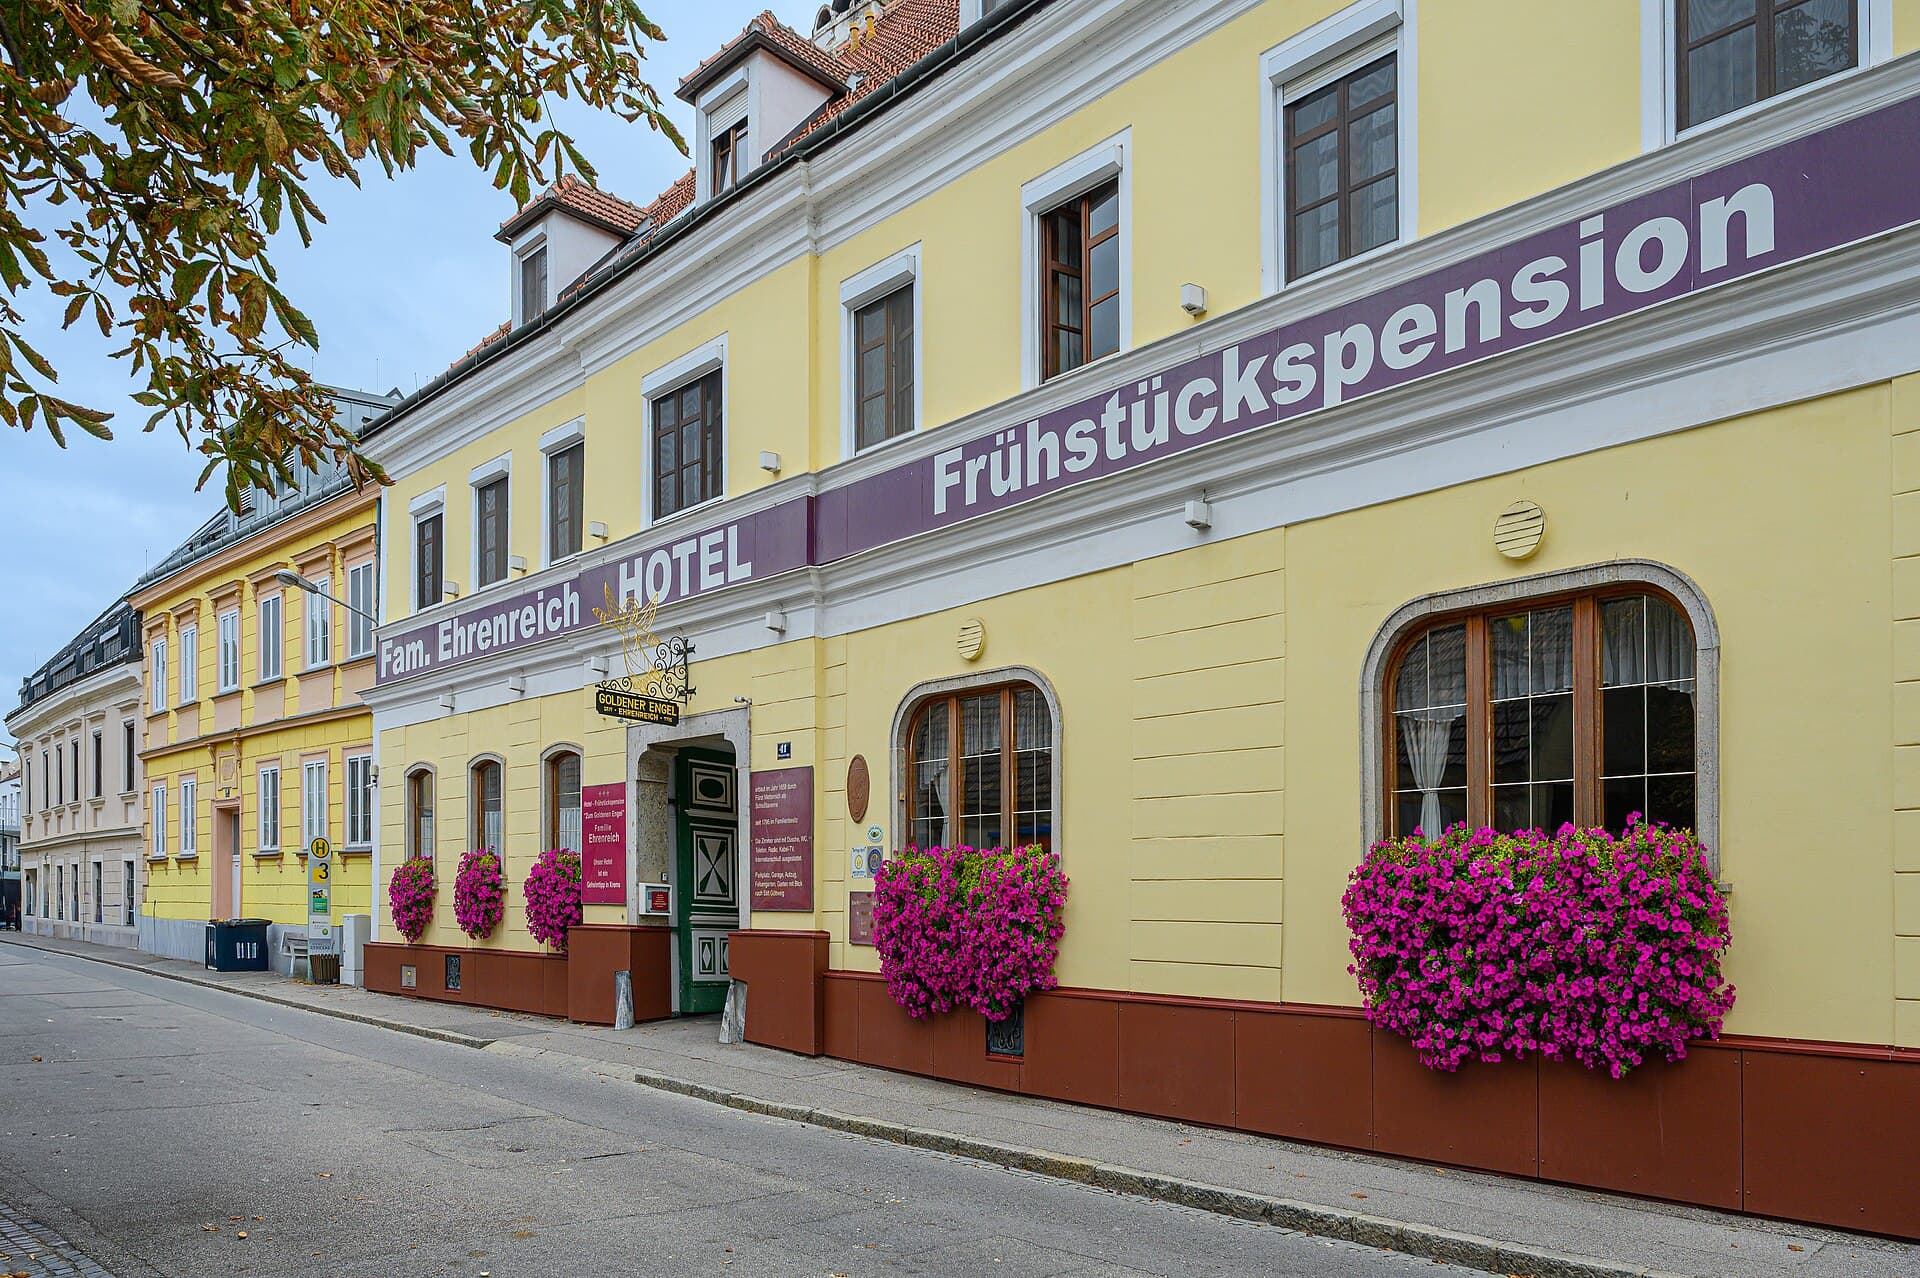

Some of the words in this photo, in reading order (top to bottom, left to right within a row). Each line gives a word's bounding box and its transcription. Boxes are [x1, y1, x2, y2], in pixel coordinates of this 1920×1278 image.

[933, 183, 1775, 516] Frühstückspension
[619, 524, 752, 613] HOTEL
[380, 638, 431, 679] Fam.
[438, 582, 580, 661] Ehrenreich
[598, 693, 646, 711] GOLDENER
[649, 701, 677, 716] ENGEL
[618, 707, 659, 721] EHRENREICH
[594, 824, 612, 832] Familie
[588, 832, 620, 844] Ehrenreich
[315, 841, 326, 855] H
[318, 862, 329, 880] 3
